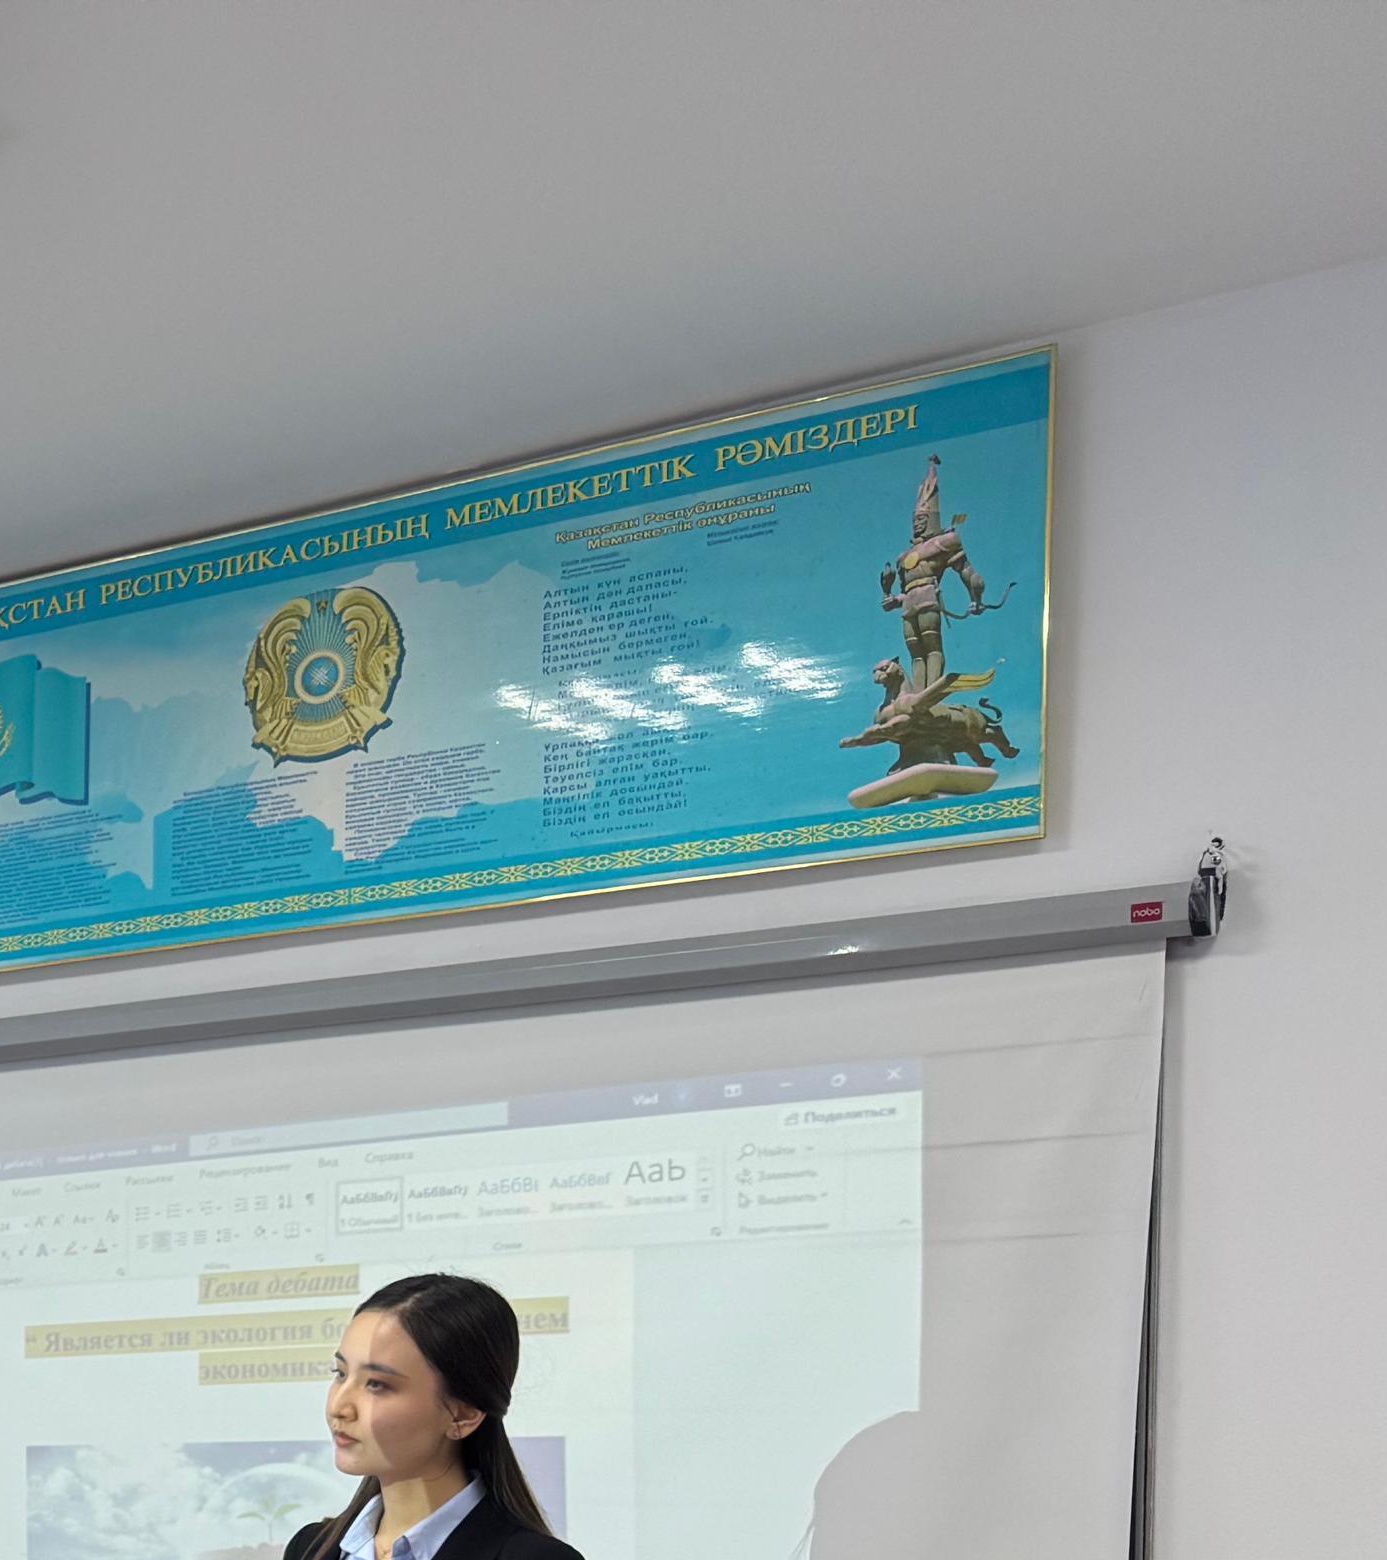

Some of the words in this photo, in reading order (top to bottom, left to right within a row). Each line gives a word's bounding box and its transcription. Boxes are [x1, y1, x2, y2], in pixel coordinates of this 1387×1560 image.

[99, 513, 430, 606] РЕСПУБЛИКАСЫНЫҢ
[445, 454, 697, 530] МЕМЛЕКЕТТІК
[715, 405, 918, 472] РӘМІЗДЕРІ
[555, 517, 639, 544] Қазақстан
[587, 522, 692, 550] Мемлекеттік
[1133, 906, 1160, 918] nobo
[632, 1092, 659, 1106] Vlad
[804, 1107, 897, 1124] Поделиться
[201, 1277, 258, 1300] Тема
[267, 1270, 360, 1295] дебата
[44, 1331, 153, 1353] Является
[160, 1330, 190, 1348] ли
[198, 1324, 312, 1347] экология
